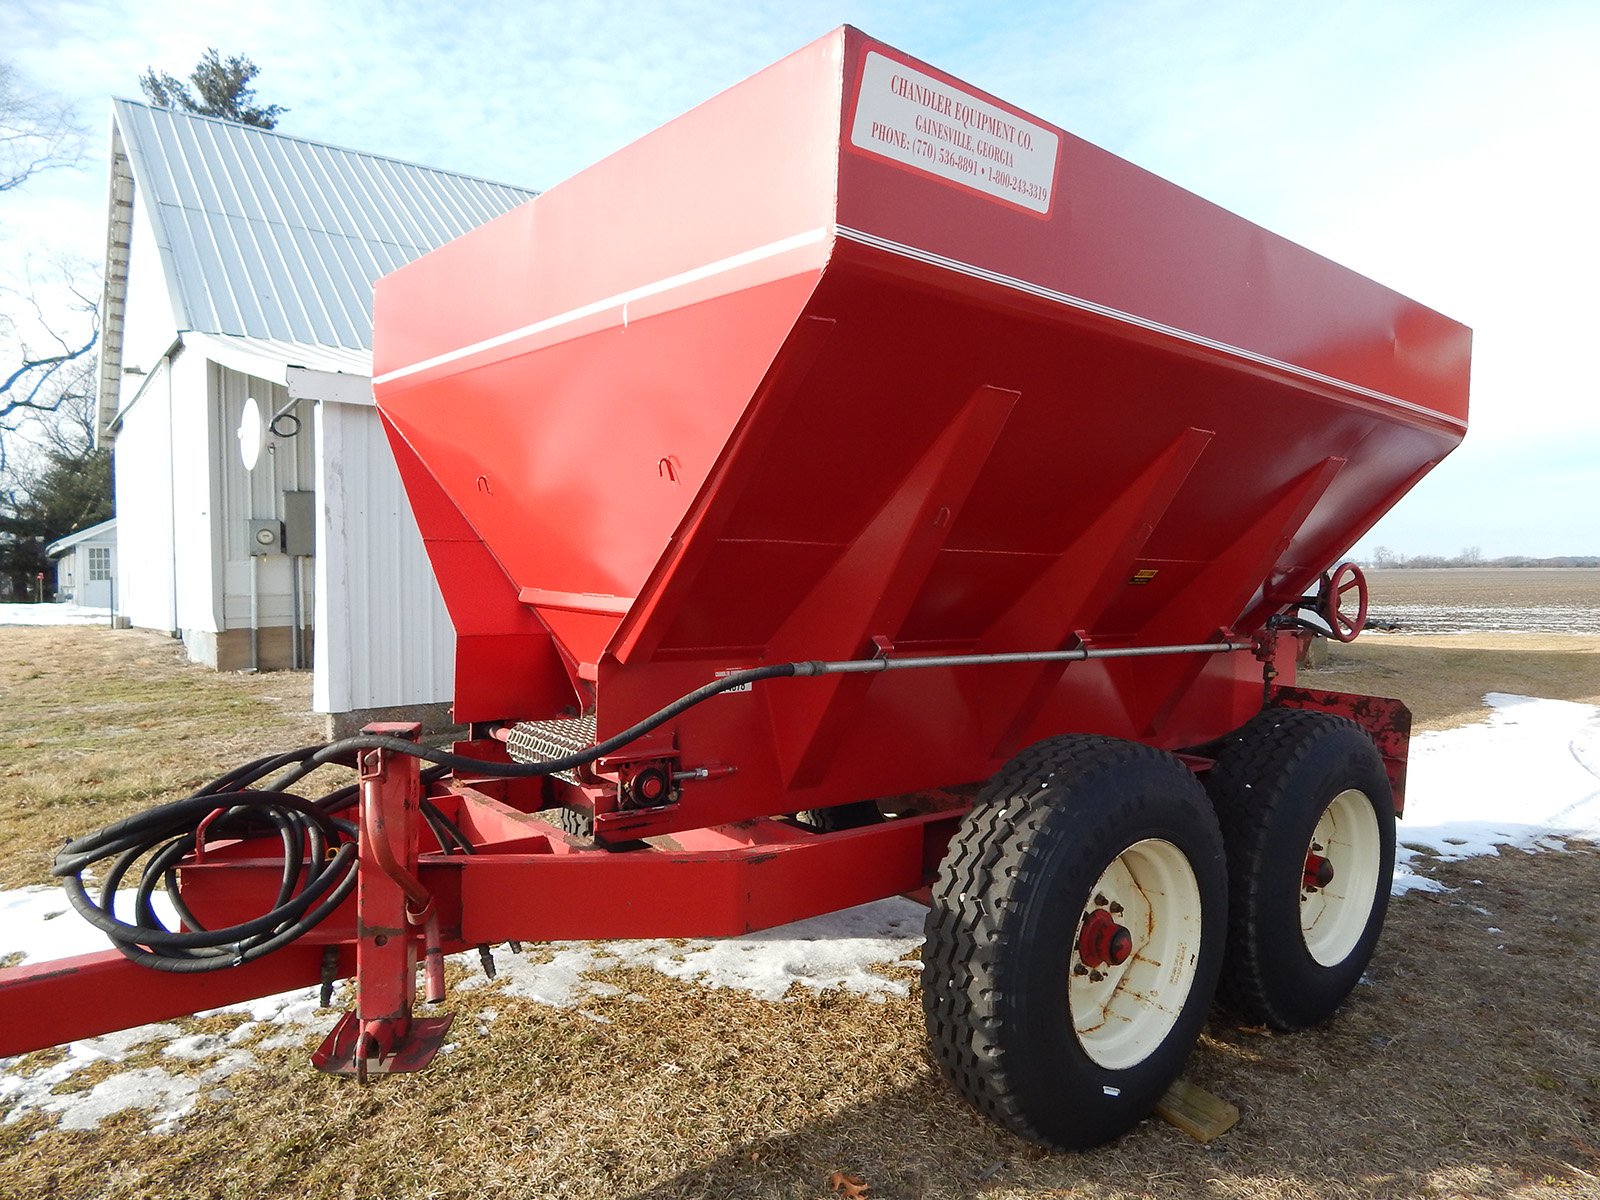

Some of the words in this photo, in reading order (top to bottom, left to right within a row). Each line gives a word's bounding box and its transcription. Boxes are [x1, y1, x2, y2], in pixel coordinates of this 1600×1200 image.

[891, 74, 951, 117] CHANDLER
[954, 102, 1015, 143] EQUIPMENT
[1017, 129, 1034, 151] CO.
[915, 114, 973, 152] GAINESVILLE,
[977, 139, 1013, 167] GEORGIA
[871, 121, 910, 150] PHONE:
[912, 137, 936, 164] (770)
[938, 148, 978, 176] 536-8891
[987, 166, 1047, 201] 1-800-243-3319
